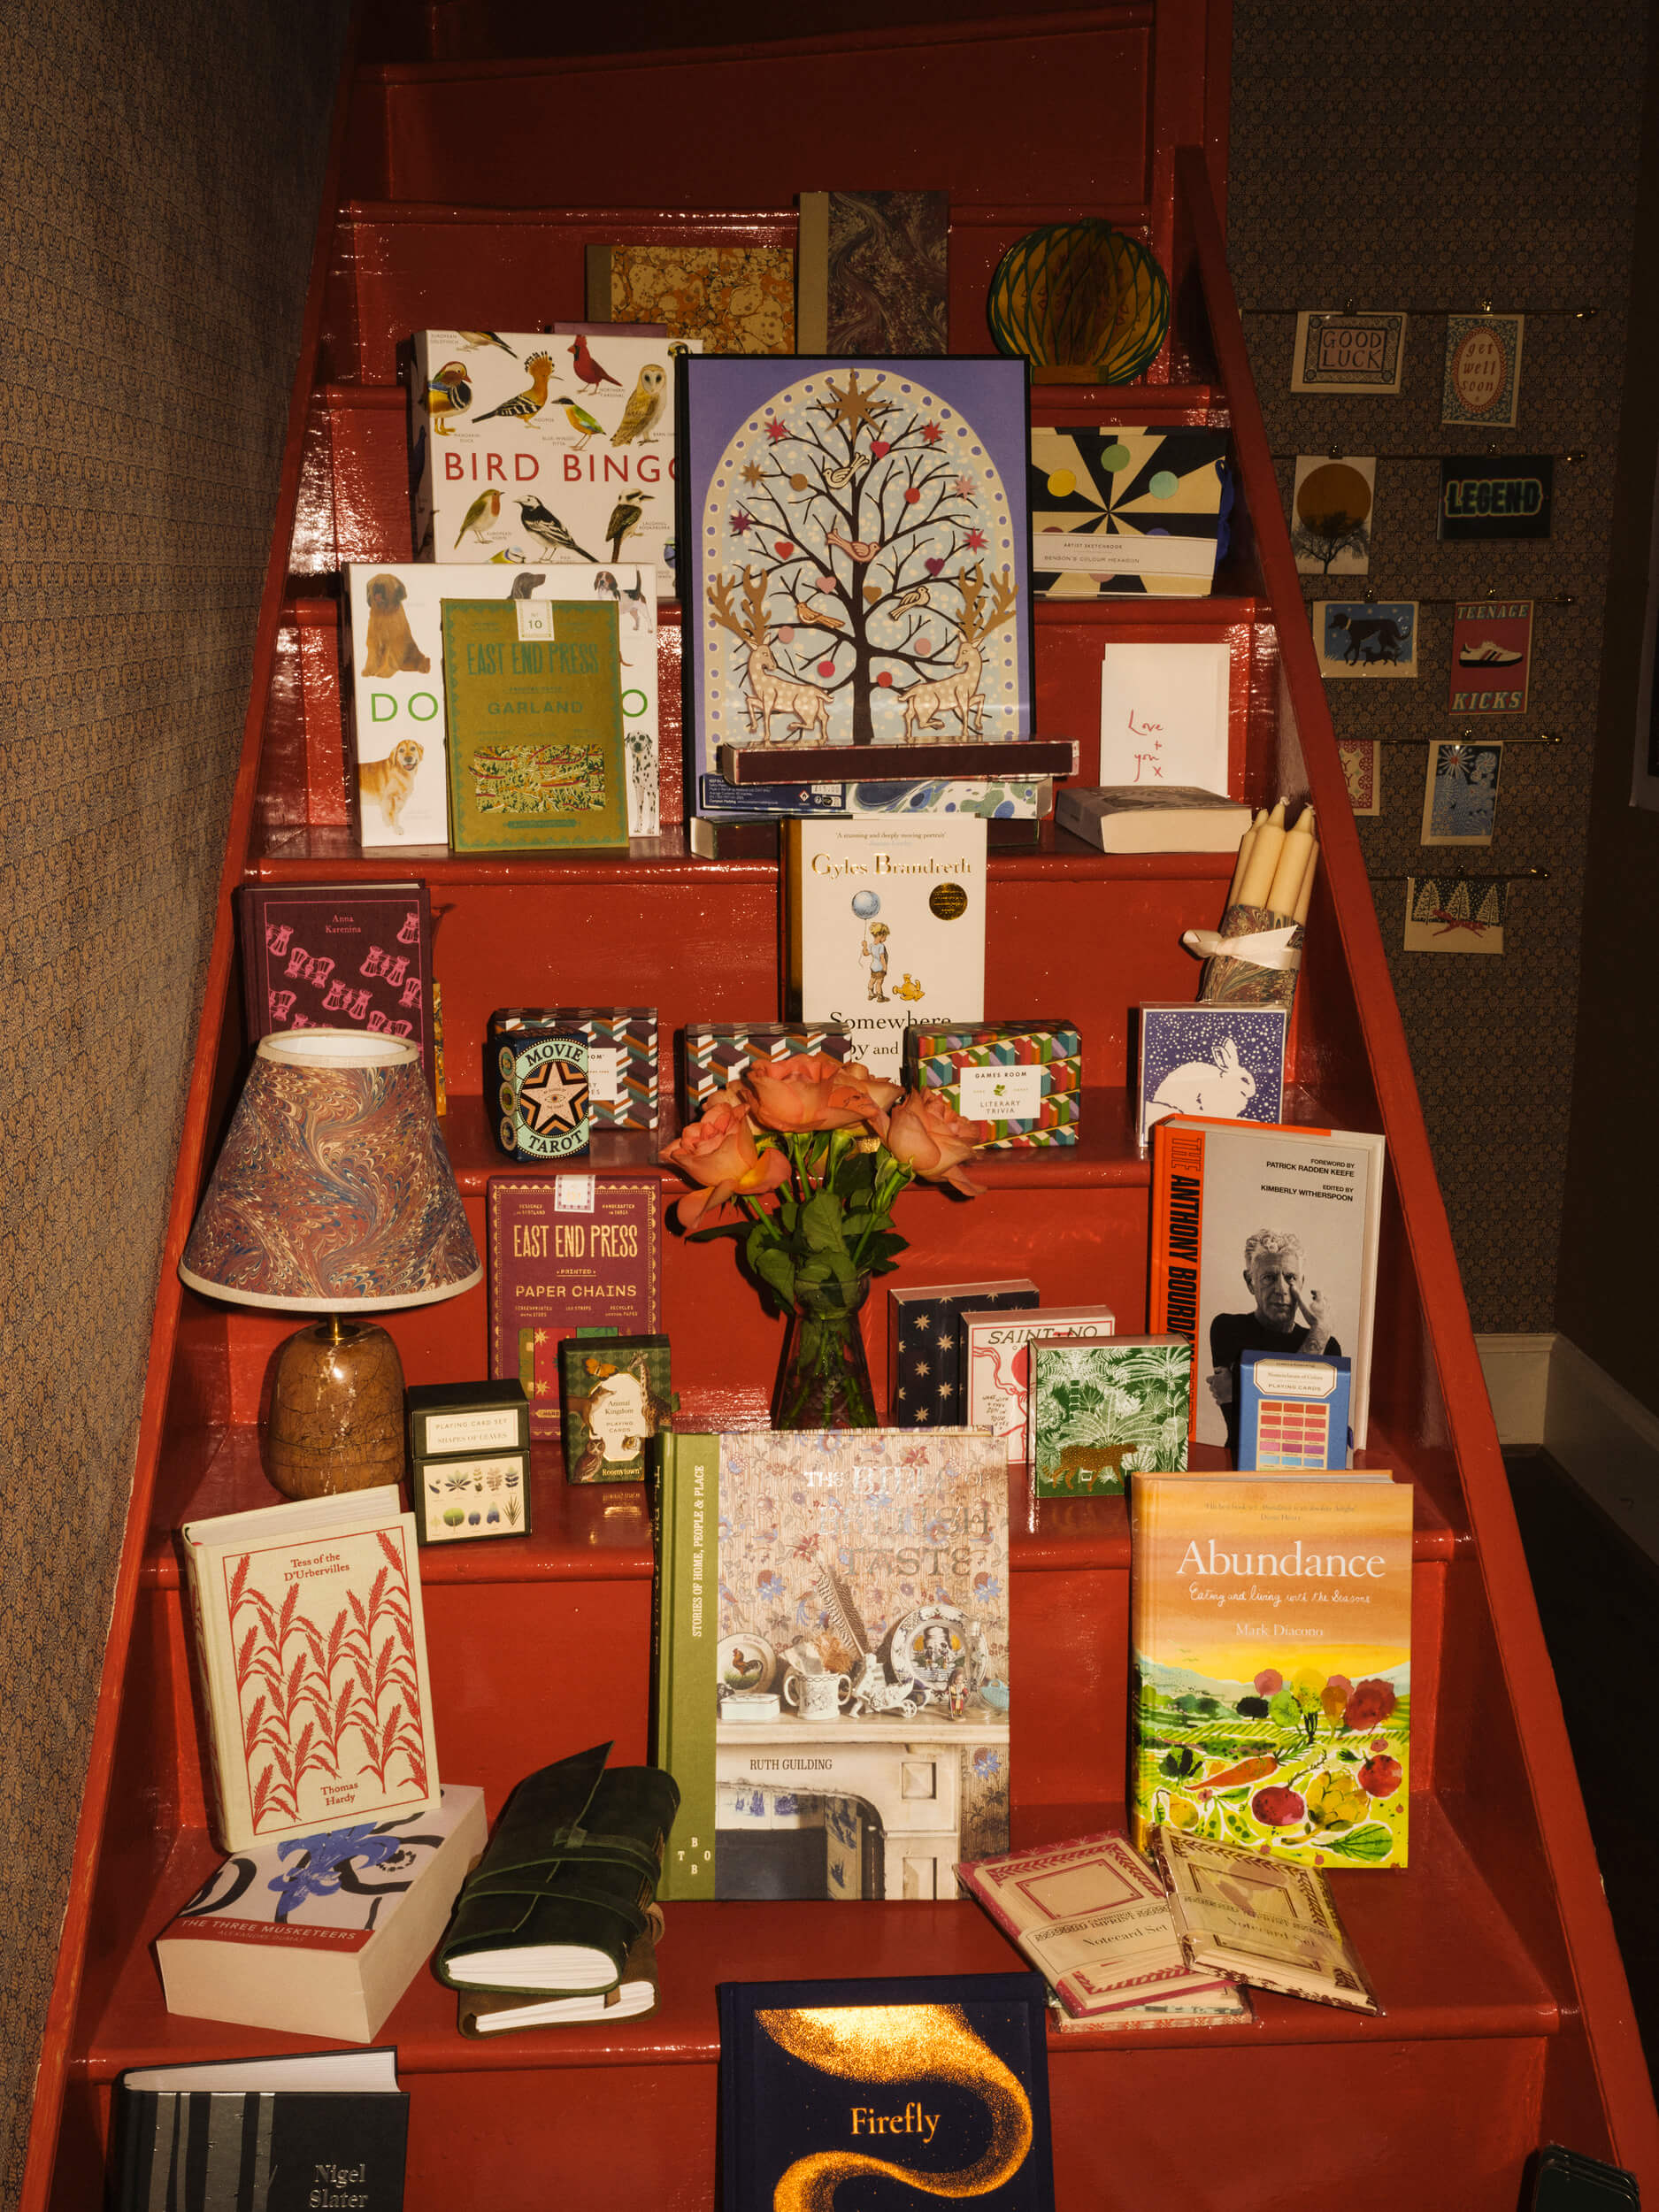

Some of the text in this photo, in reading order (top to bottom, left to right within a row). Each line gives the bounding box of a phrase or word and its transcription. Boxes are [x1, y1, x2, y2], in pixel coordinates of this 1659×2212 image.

[1323, 331, 1381, 348] GOOD
[1323, 349, 1381, 368] LUCK
[1465, 343, 1494, 357] get
[1463, 360, 1495, 375] well
[1461, 380, 1494, 392] soon
[444, 452, 674, 482] BIRD BING
[1446, 479, 1542, 516] LEGEND
[1457, 604, 1530, 620] TEENAGE
[528, 620, 542, 629] 10
[466, 643, 599, 675] EAST END PRESS
[371, 692, 439, 722] DO
[488, 701, 583, 716] GARLAND
[1452, 691, 1523, 711] KICKS
[1128, 709, 1164, 735] Love
[811, 852, 972, 879] Gyles Brandreth
[332, 914, 355, 923] Anna
[525, 1043, 583, 1067] MOVIE
[872, 1041, 899, 1055] and
[528, 1130, 582, 1153] TAROT
[1171, 1137, 1202, 1172] THE
[1310, 1158, 1345, 1168] FOREWORD
[1266, 1161, 1355, 1178] PATRICK RADDEN KEEFE
[1261, 1185, 1353, 1202] KIMBERLY WITHERSPOON
[1168, 1173, 1201, 1267] ANTHONY
[513, 1225, 638, 1258] EAST END PRESS
[516, 1285, 637, 1297] PAPER CHAINS
[805, 1471, 843, 1487] THE
[851, 1465, 954, 1495] BIBLE
[818, 1506, 990, 1536] BRITISH
[290, 1553, 340, 1568] Tess of the
[692, 1465, 705, 1637] STORIES OF HOME, PEOPLE & PLACE
[1175, 1539, 1386, 1578] Abundance
[283, 1563, 350, 1581] D'Urbervilles
[838, 1548, 972, 1577] TASTE
[1189, 1581, 1225, 1607] Eating
[1227, 1591, 1247, 1601] and
[1250, 1585, 1281, 1607] living
[1236, 1624, 1324, 1636] Mark Diacono
[749, 1758, 833, 1770] RUTH GUILDING
[320, 1783, 358, 1795] Thomas
[326, 1793, 355, 1806] Hardy
[212, 1920, 257, 1932] THREE
[262, 1925, 357, 1940] MUSKETEERS
[1090, 1915, 1137, 1929] IMPRINT
[1082, 1924, 1169, 1946] Notecard Set
[849, 2101, 941, 2144] Firefly
[313, 2163, 366, 2188] Nigel
[310, 2188, 369, 2208] Slater
